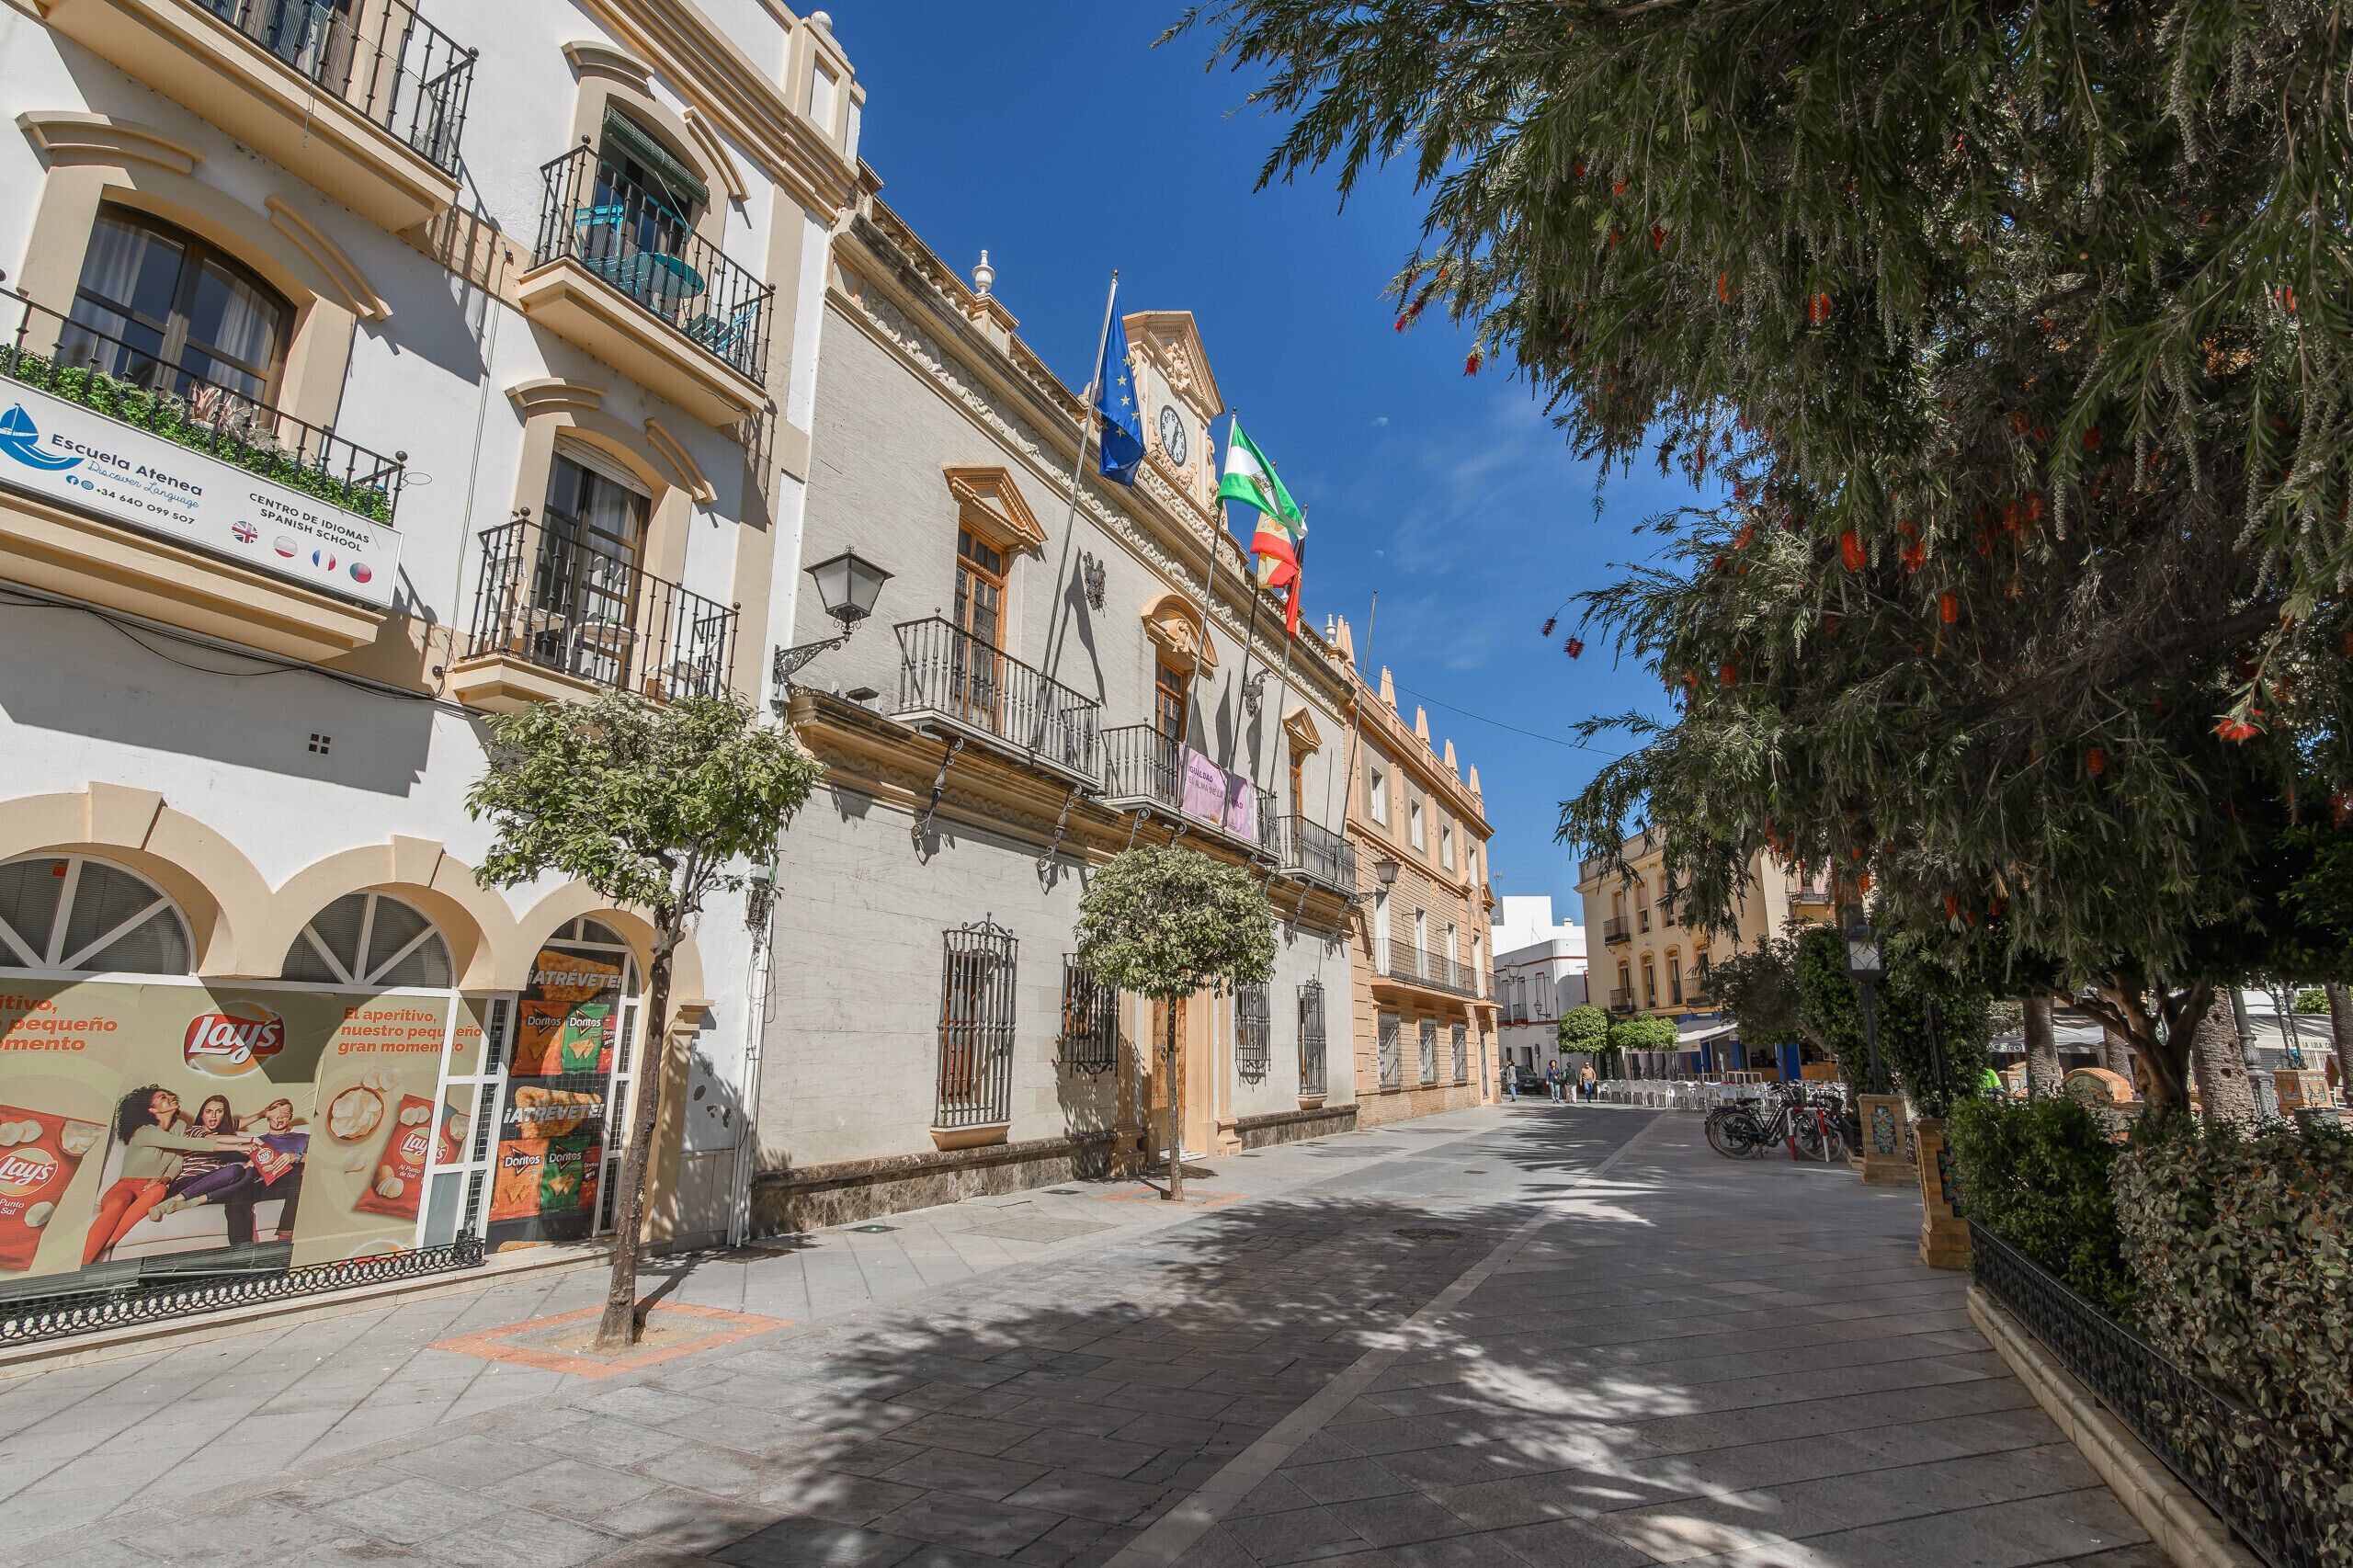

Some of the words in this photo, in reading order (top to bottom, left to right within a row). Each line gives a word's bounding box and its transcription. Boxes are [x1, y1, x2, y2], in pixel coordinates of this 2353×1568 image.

[51, 434, 131, 471] Escuela
[135, 465, 202, 496] Atenea
[87, 460, 142, 488] Discover
[144, 482, 199, 509] Language
[96, 488, 116, 498] +34
[119, 494, 143, 507] 640
[147, 504, 169, 517] 099
[172, 513, 195, 525] 507
[249, 493, 299, 517] CENTRO
[302, 512, 319, 525] DE
[321, 519, 369, 543] IDIOMAS
[260, 508, 313, 534] SPANISH
[315, 529, 362, 552] SCHOOL
[528, 969, 623, 989] ¡ATRÉVETE!
[344, 1006, 360, 1020] El
[362, 1008, 438, 1024] aperitivo,
[527, 1016, 562, 1027] Doritos
[569, 1016, 601, 1028] Doritos
[7, 1016, 118, 1035] pequeño
[341, 1025, 404, 1037] nuestro
[188, 1016, 280, 1065] Lay's
[337, 1041, 377, 1056] gran
[503, 1102, 606, 1124] ¡ATRÉVETE!
[505, 1155, 540, 1167] Doritos
[549, 1152, 583, 1163] Doritos
[405, 1165, 422, 1174] Punto
[1, 1207, 17, 1215] Sal
